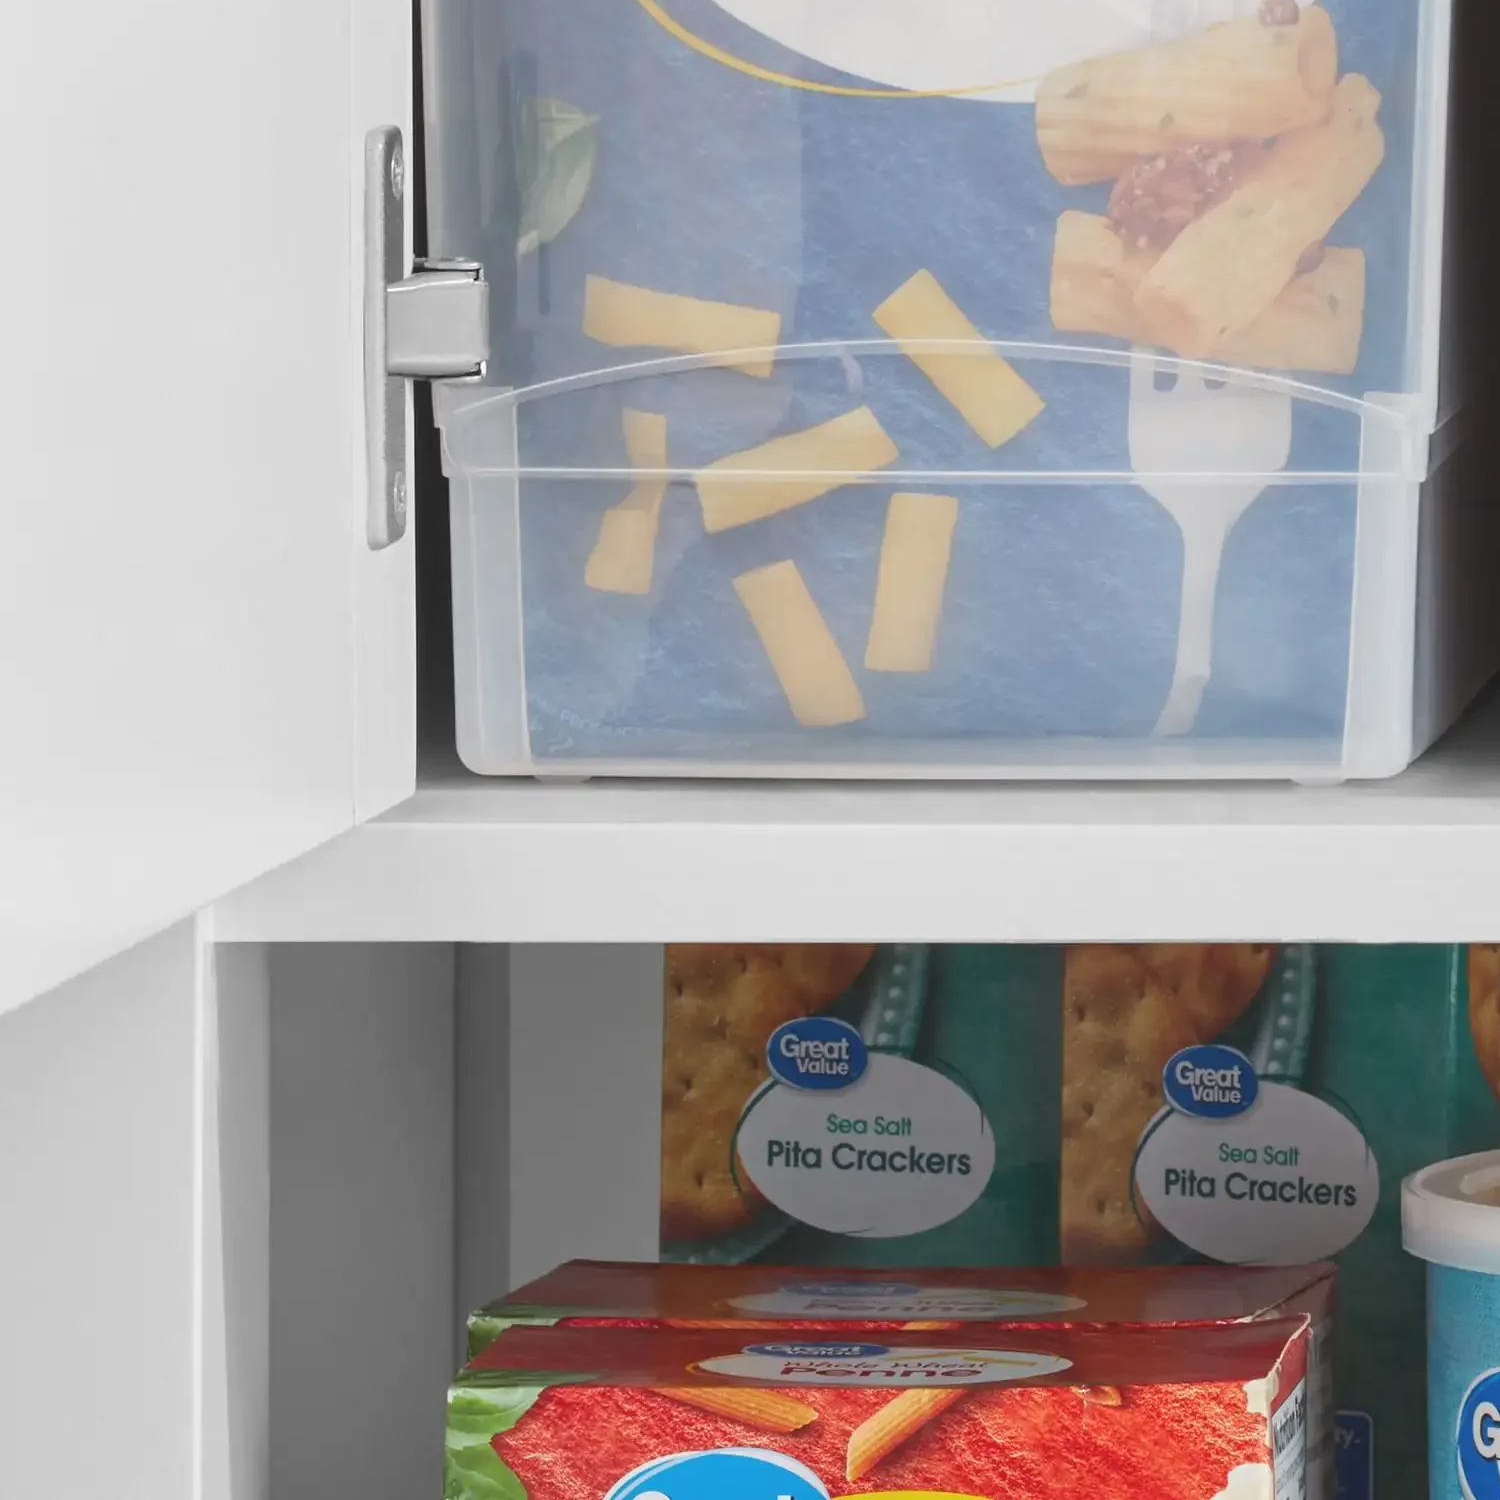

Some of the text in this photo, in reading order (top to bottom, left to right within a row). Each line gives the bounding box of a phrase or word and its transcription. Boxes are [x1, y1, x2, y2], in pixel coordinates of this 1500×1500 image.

[779, 1033, 850, 1061] Great
[796, 1057, 850, 1076] Value
[1174, 1060, 1242, 1089] Great
[1191, 1085, 1242, 1104] Value
[826, 1113, 913, 1137] Sea Salt
[767, 1139, 972, 1176] Pita Crackers
[1218, 1142, 1300, 1167] Sea Salt
[1164, 1167, 1358, 1208] Pita Crackers
[779, 1366, 983, 1378] Penne
[783, 1360, 991, 1369] Whole Wheat
